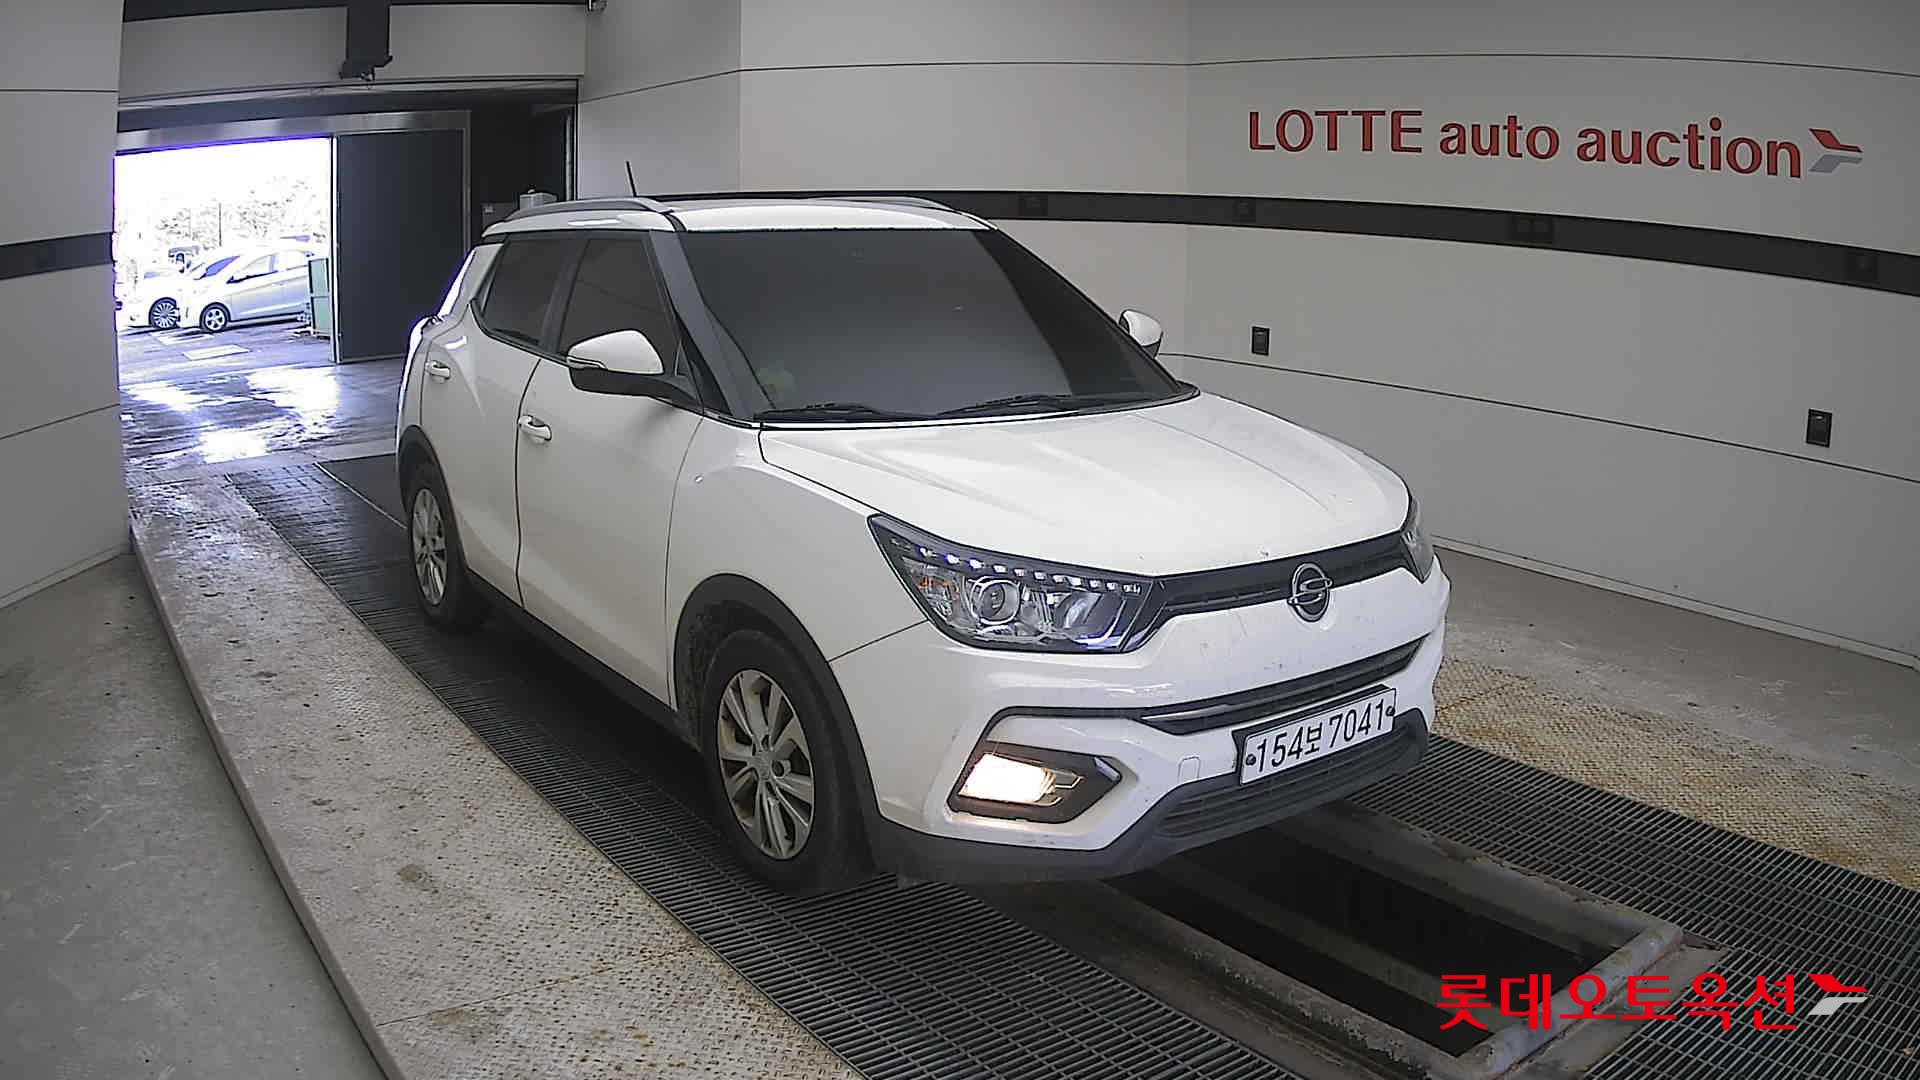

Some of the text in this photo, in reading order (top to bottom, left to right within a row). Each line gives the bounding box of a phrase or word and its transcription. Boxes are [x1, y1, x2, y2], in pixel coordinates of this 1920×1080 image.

[1249, 110, 1803, 178] LOTTE auto auction
[1329, 698, 1384, 748] 7041
